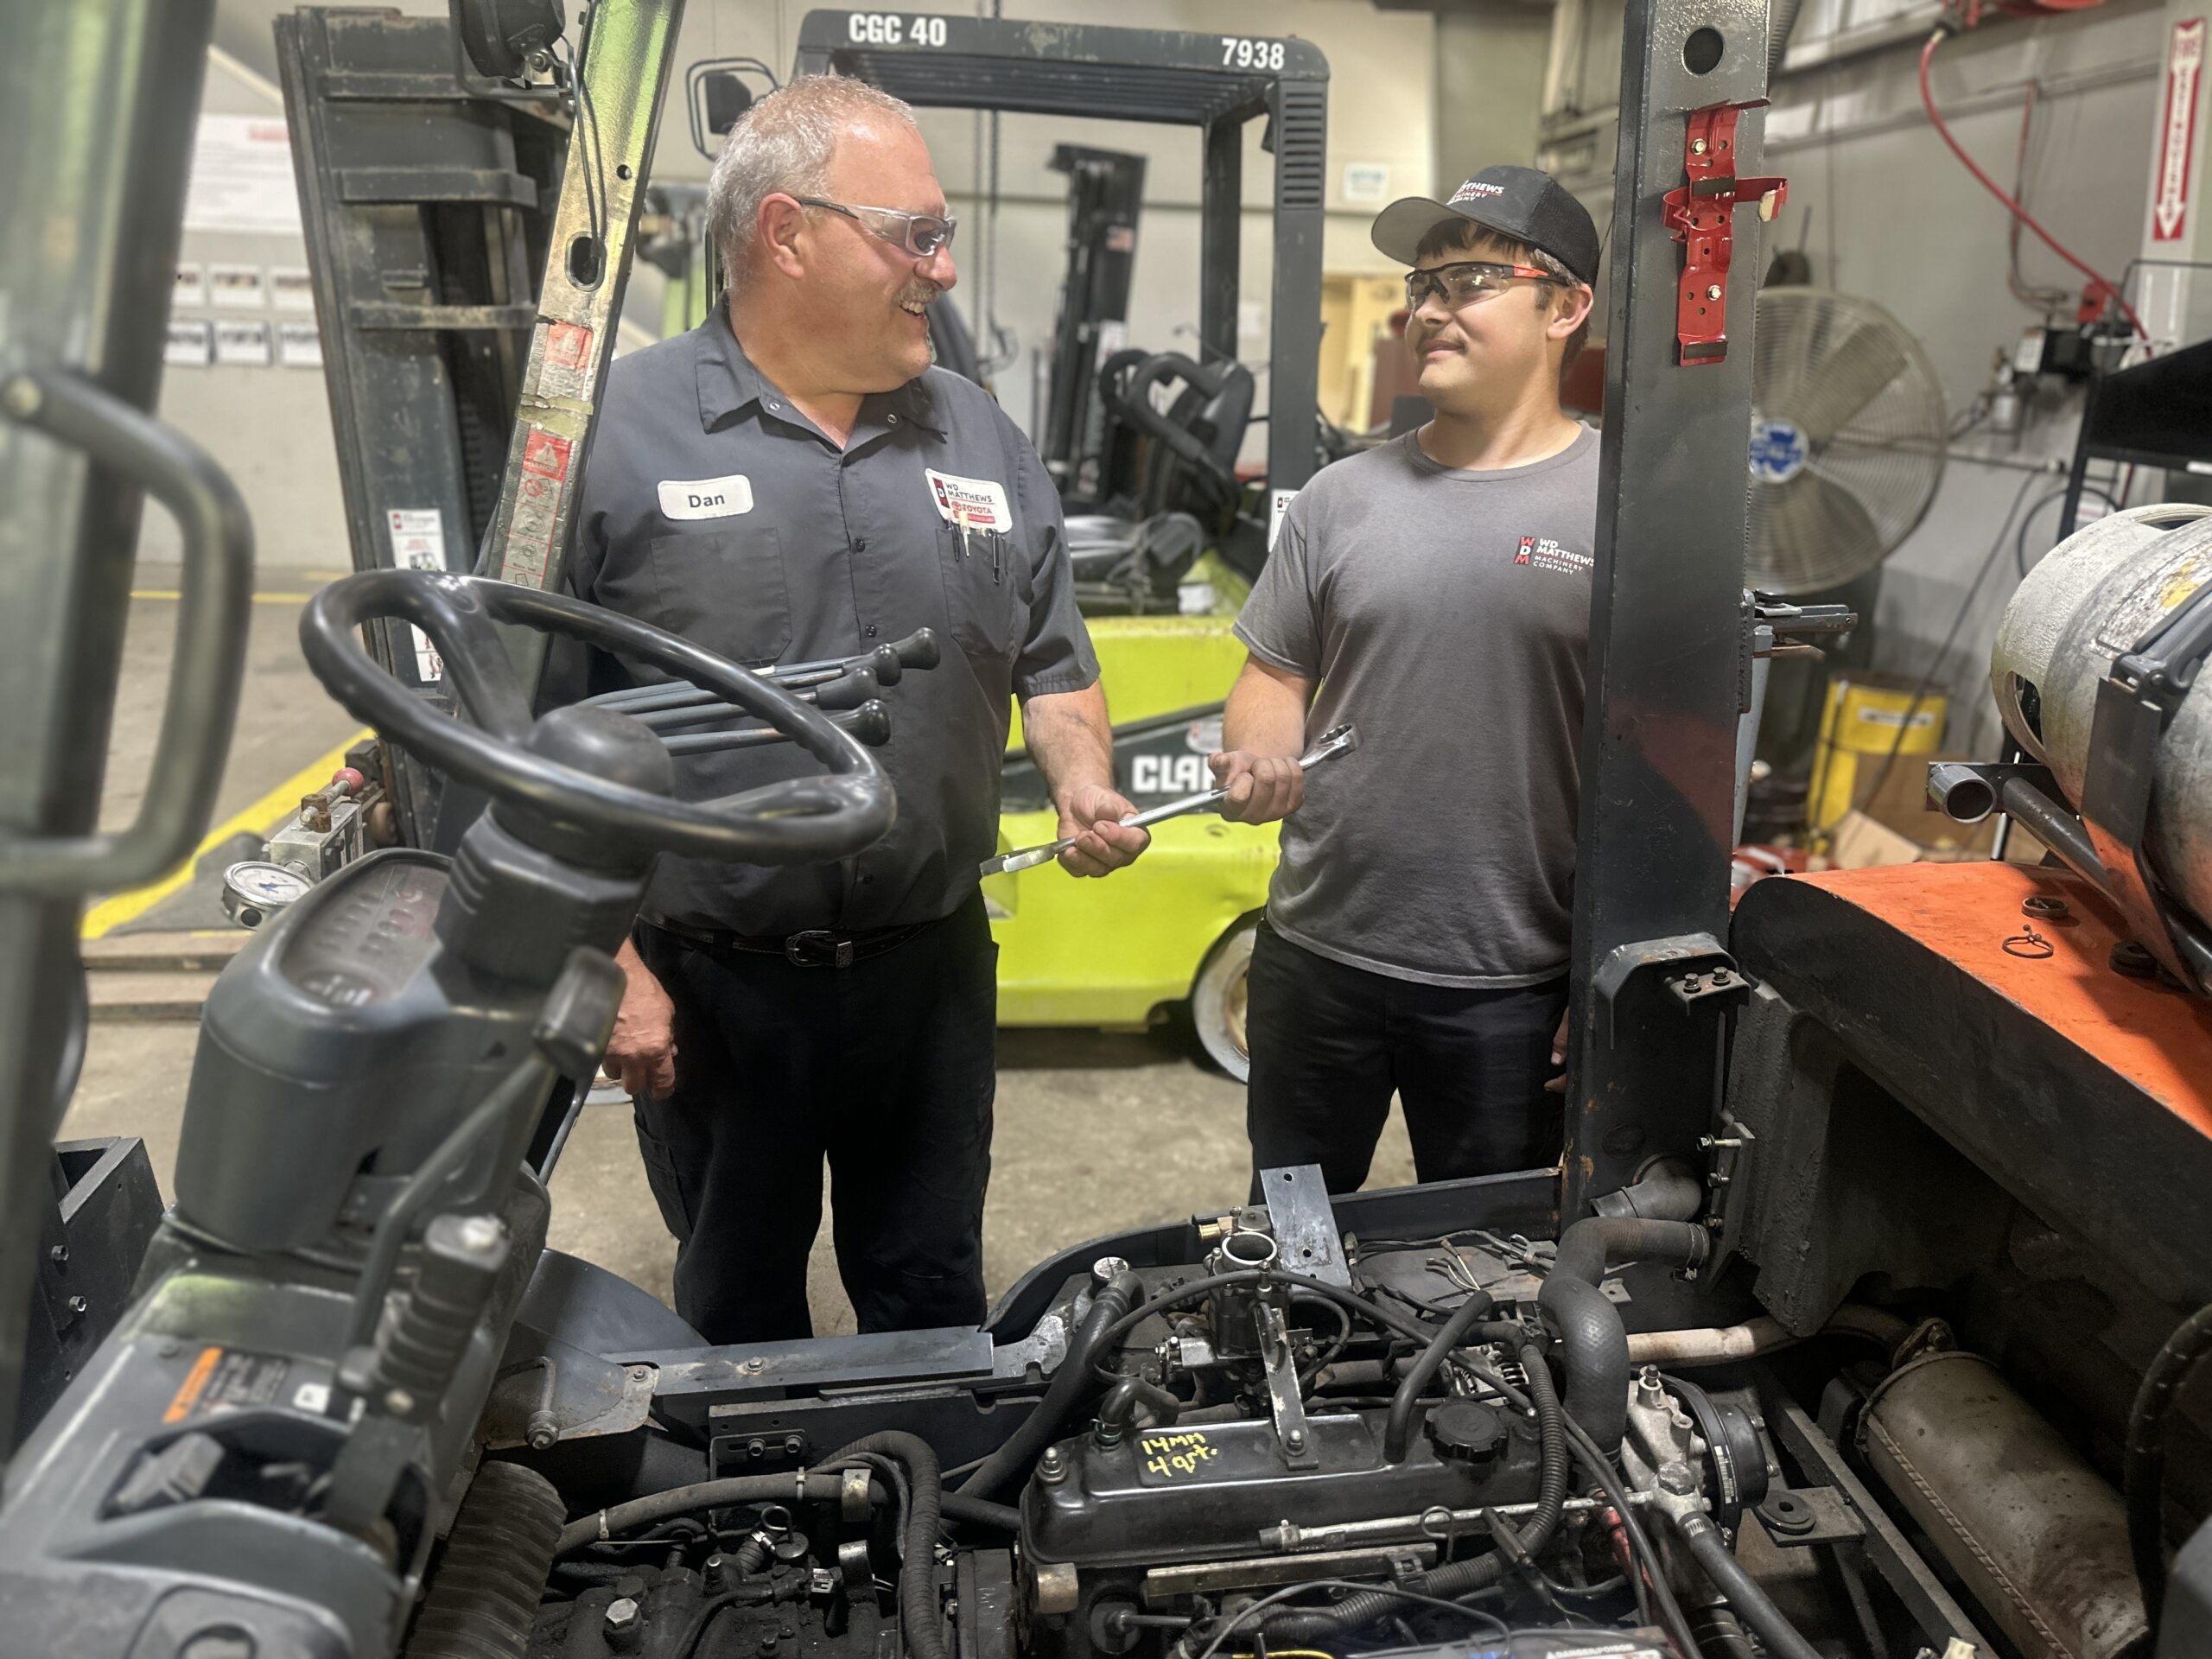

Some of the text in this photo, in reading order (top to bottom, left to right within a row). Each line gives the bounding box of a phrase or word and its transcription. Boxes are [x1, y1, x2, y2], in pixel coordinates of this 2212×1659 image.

[849, 13, 947, 47] CGC 40
[1221, 37, 1285, 71] 7938
[945, 482, 959, 491] WD
[688, 494, 725, 508] Dan
[948, 489, 993, 502] MATTHEWS
[961, 503, 993, 514] TOYOTA
[1539, 537, 1559, 549] WD
[1533, 561, 1573, 575] COMPANY
[1535, 555, 1583, 572] MACHINERY
